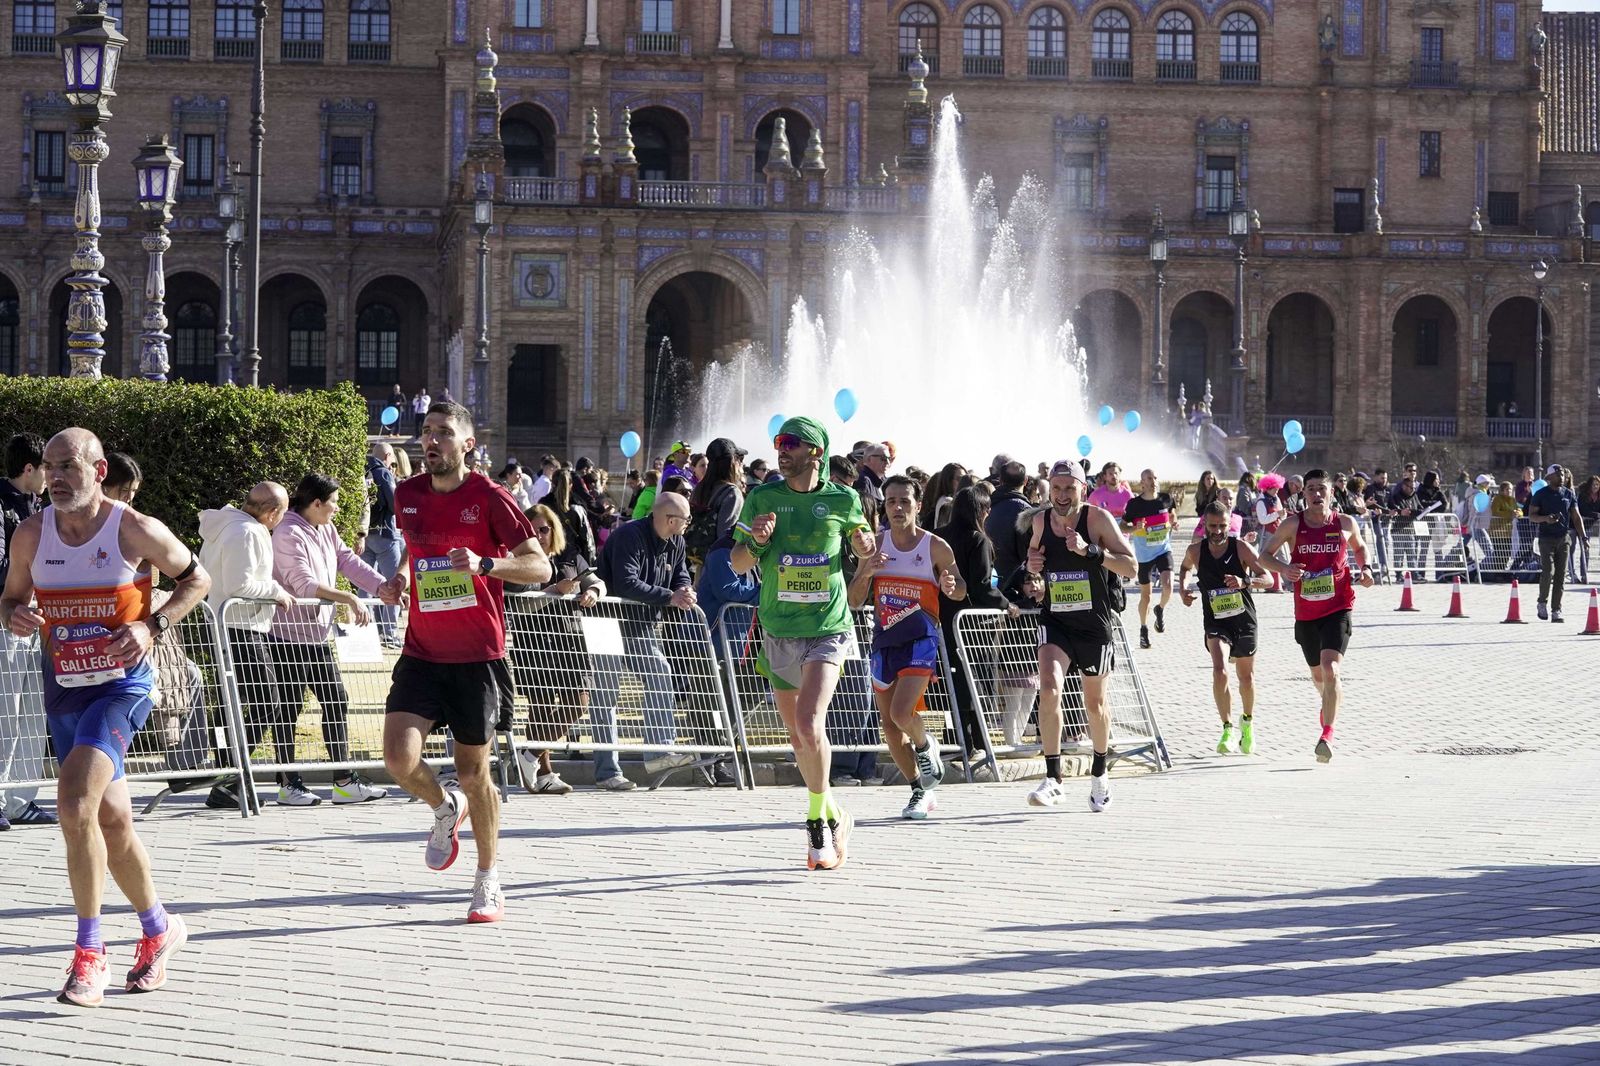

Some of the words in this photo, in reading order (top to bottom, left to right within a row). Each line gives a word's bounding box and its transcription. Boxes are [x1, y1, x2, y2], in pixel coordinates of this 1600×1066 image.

[1298, 544, 1340, 553] VENEZUELA
[431, 559, 453, 570] ZURIC
[796, 556, 824, 564] ZURICH
[787, 580, 822, 591] PERICO
[1304, 586, 1332, 594] RICARDO
[424, 584, 468, 599] BASTIEN
[878, 586, 921, 600] MARCHENA
[1055, 593, 1084, 602] MARCO
[43, 604, 117, 619] MARCHENA
[1217, 602, 1239, 611] RAMOS
[73, 645, 95, 655] 1316
